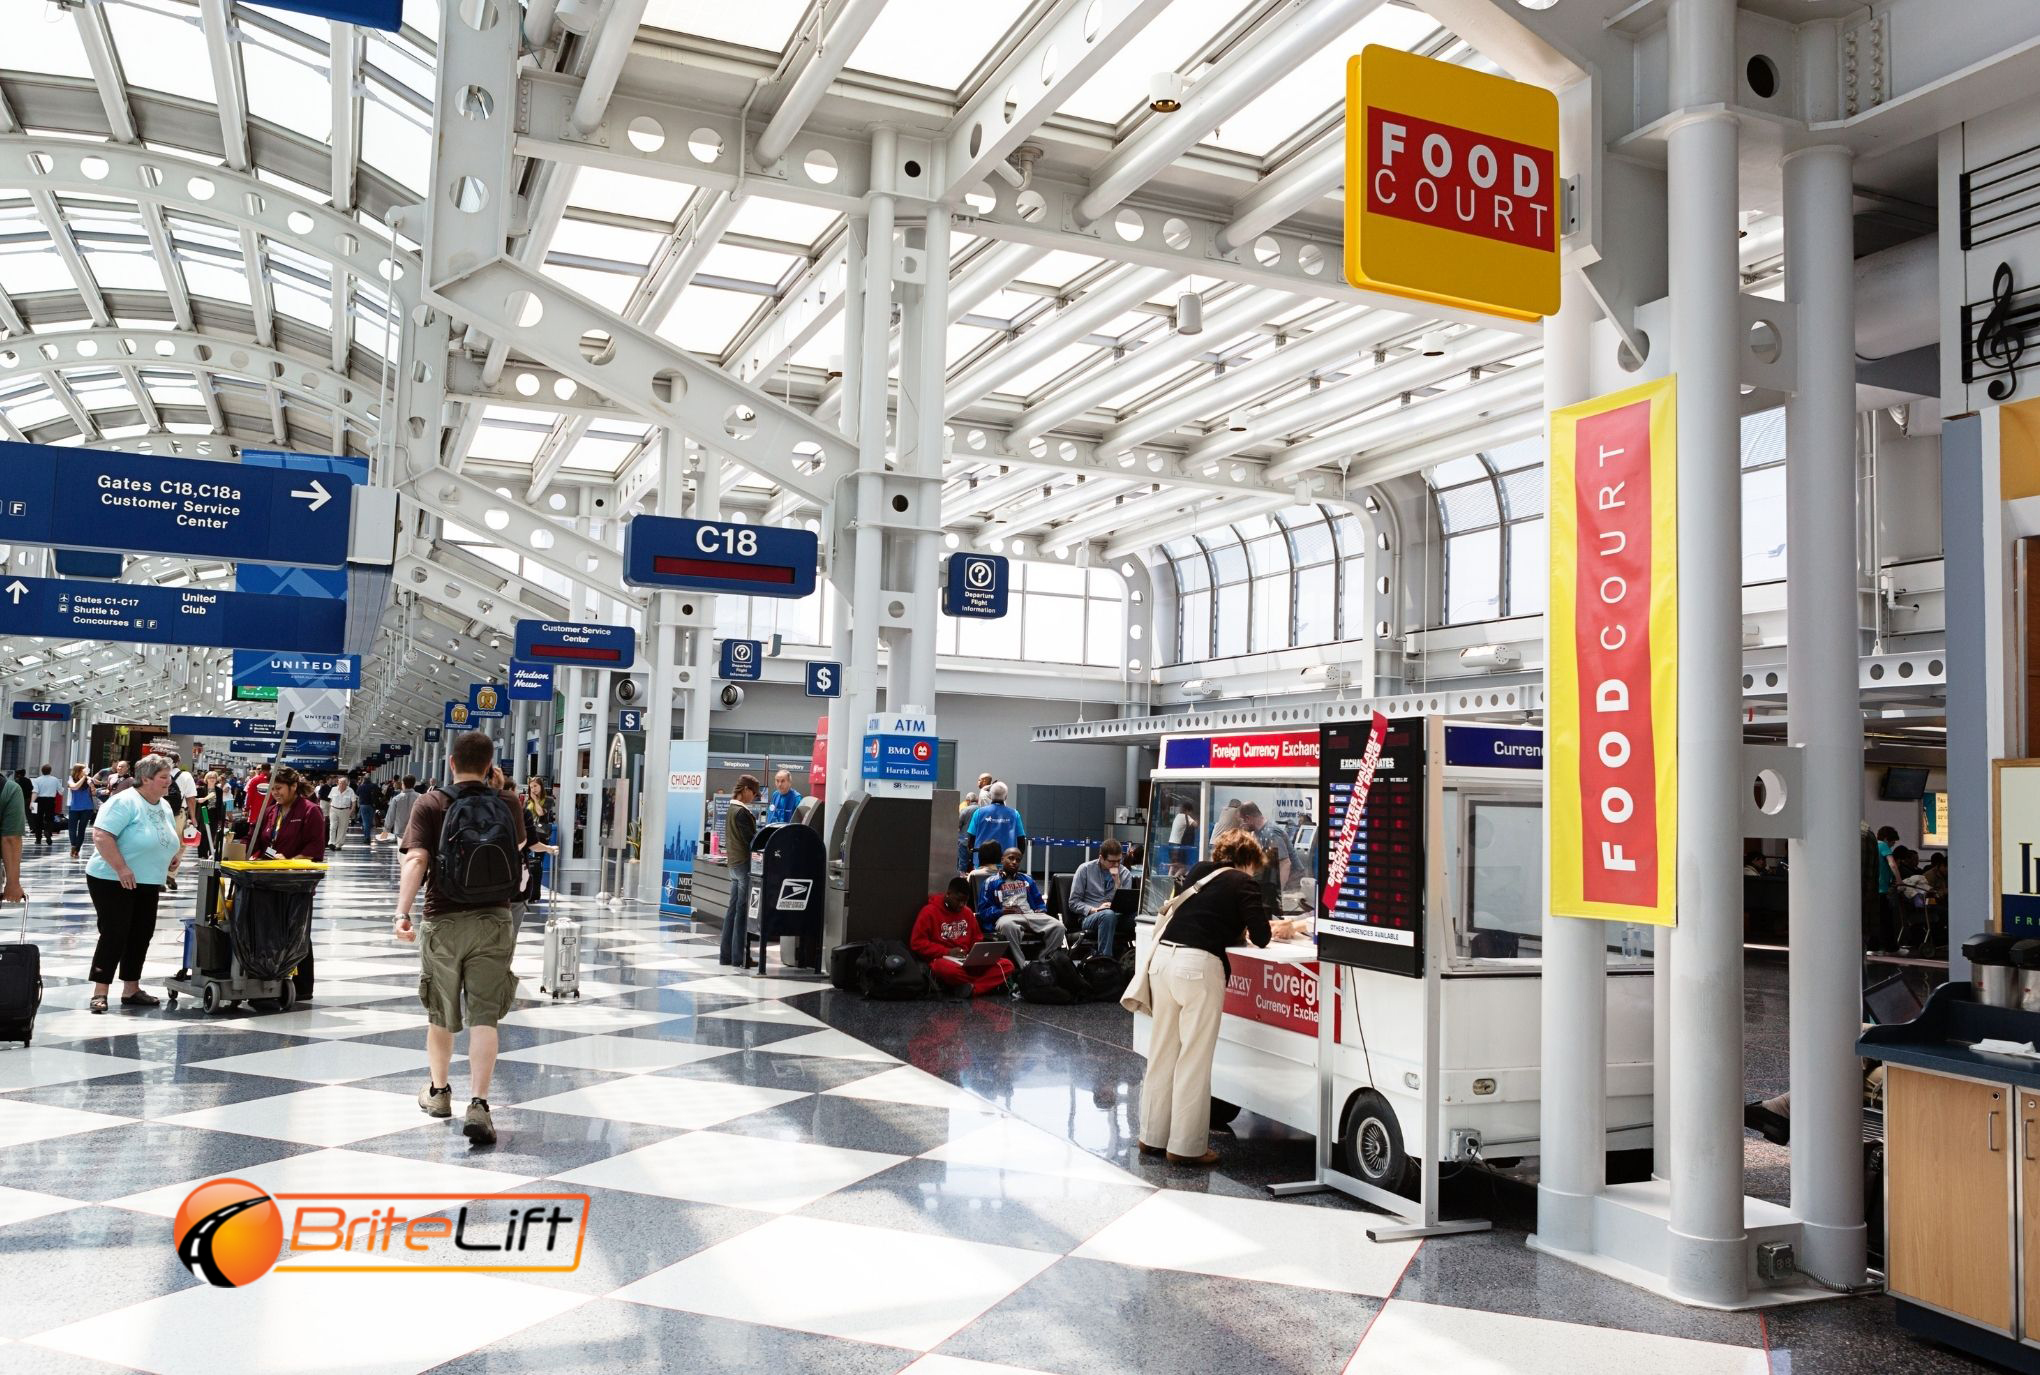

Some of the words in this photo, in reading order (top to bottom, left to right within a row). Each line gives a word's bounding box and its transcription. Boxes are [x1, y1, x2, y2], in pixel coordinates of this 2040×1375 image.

[1382, 121, 1539, 198] FOOD
[1375, 169, 1547, 237] COURT
[97, 474, 152, 492] Gates
[160, 480, 241, 500] C18,C18a
[12, 503, 22, 514] F
[101, 493, 177, 510] Customer
[183, 498, 240, 516] Service
[176, 515, 228, 529] Center
[696, 525, 757, 556] C18
[1599, 445, 1627, 651] COURT
[74, 595, 102, 605] Gates
[104, 597, 139, 607] C1-C17
[182, 593, 216, 604] United
[965, 591, 994, 599] Departure
[73, 606, 108, 615] Shuttle
[109, 608, 120, 616] to
[181, 604, 206, 615] Club
[962, 605, 996, 613] Information
[73, 616, 129, 627] Concourses
[542, 624, 580, 633] Customer
[582, 627, 611, 635] Service
[562, 635, 589, 643] Center
[271, 660, 332, 670] UNITED
[514, 670, 549, 680] Hudson
[514, 680, 541, 688] News
[32, 703, 51, 712] C17
[895, 719, 925, 732] ATM
[888, 746, 910, 755] BMO
[1213, 743, 1240, 760] Foreign
[1243, 742, 1279, 760] Currency
[1494, 741, 1543, 757] Curren
[886, 767, 910, 775] Harris
[1596, 678, 1636, 871] FOOD
[671, 775, 701, 786] CHICAGO
[1351, 787, 1368, 825] VALUE
[1364, 742, 1382, 785] PACKS
[1328, 839, 1346, 887] SPECIAL
[1341, 796, 1358, 836] RATES
[1353, 728, 1379, 795] AVAILABLE
[1345, 927, 1373, 937] CURRENCIES
[1374, 931, 1399, 940] AVAILABLE
[1264, 964, 1319, 1006] Foreig
[1256, 995, 1291, 1018] Currency
